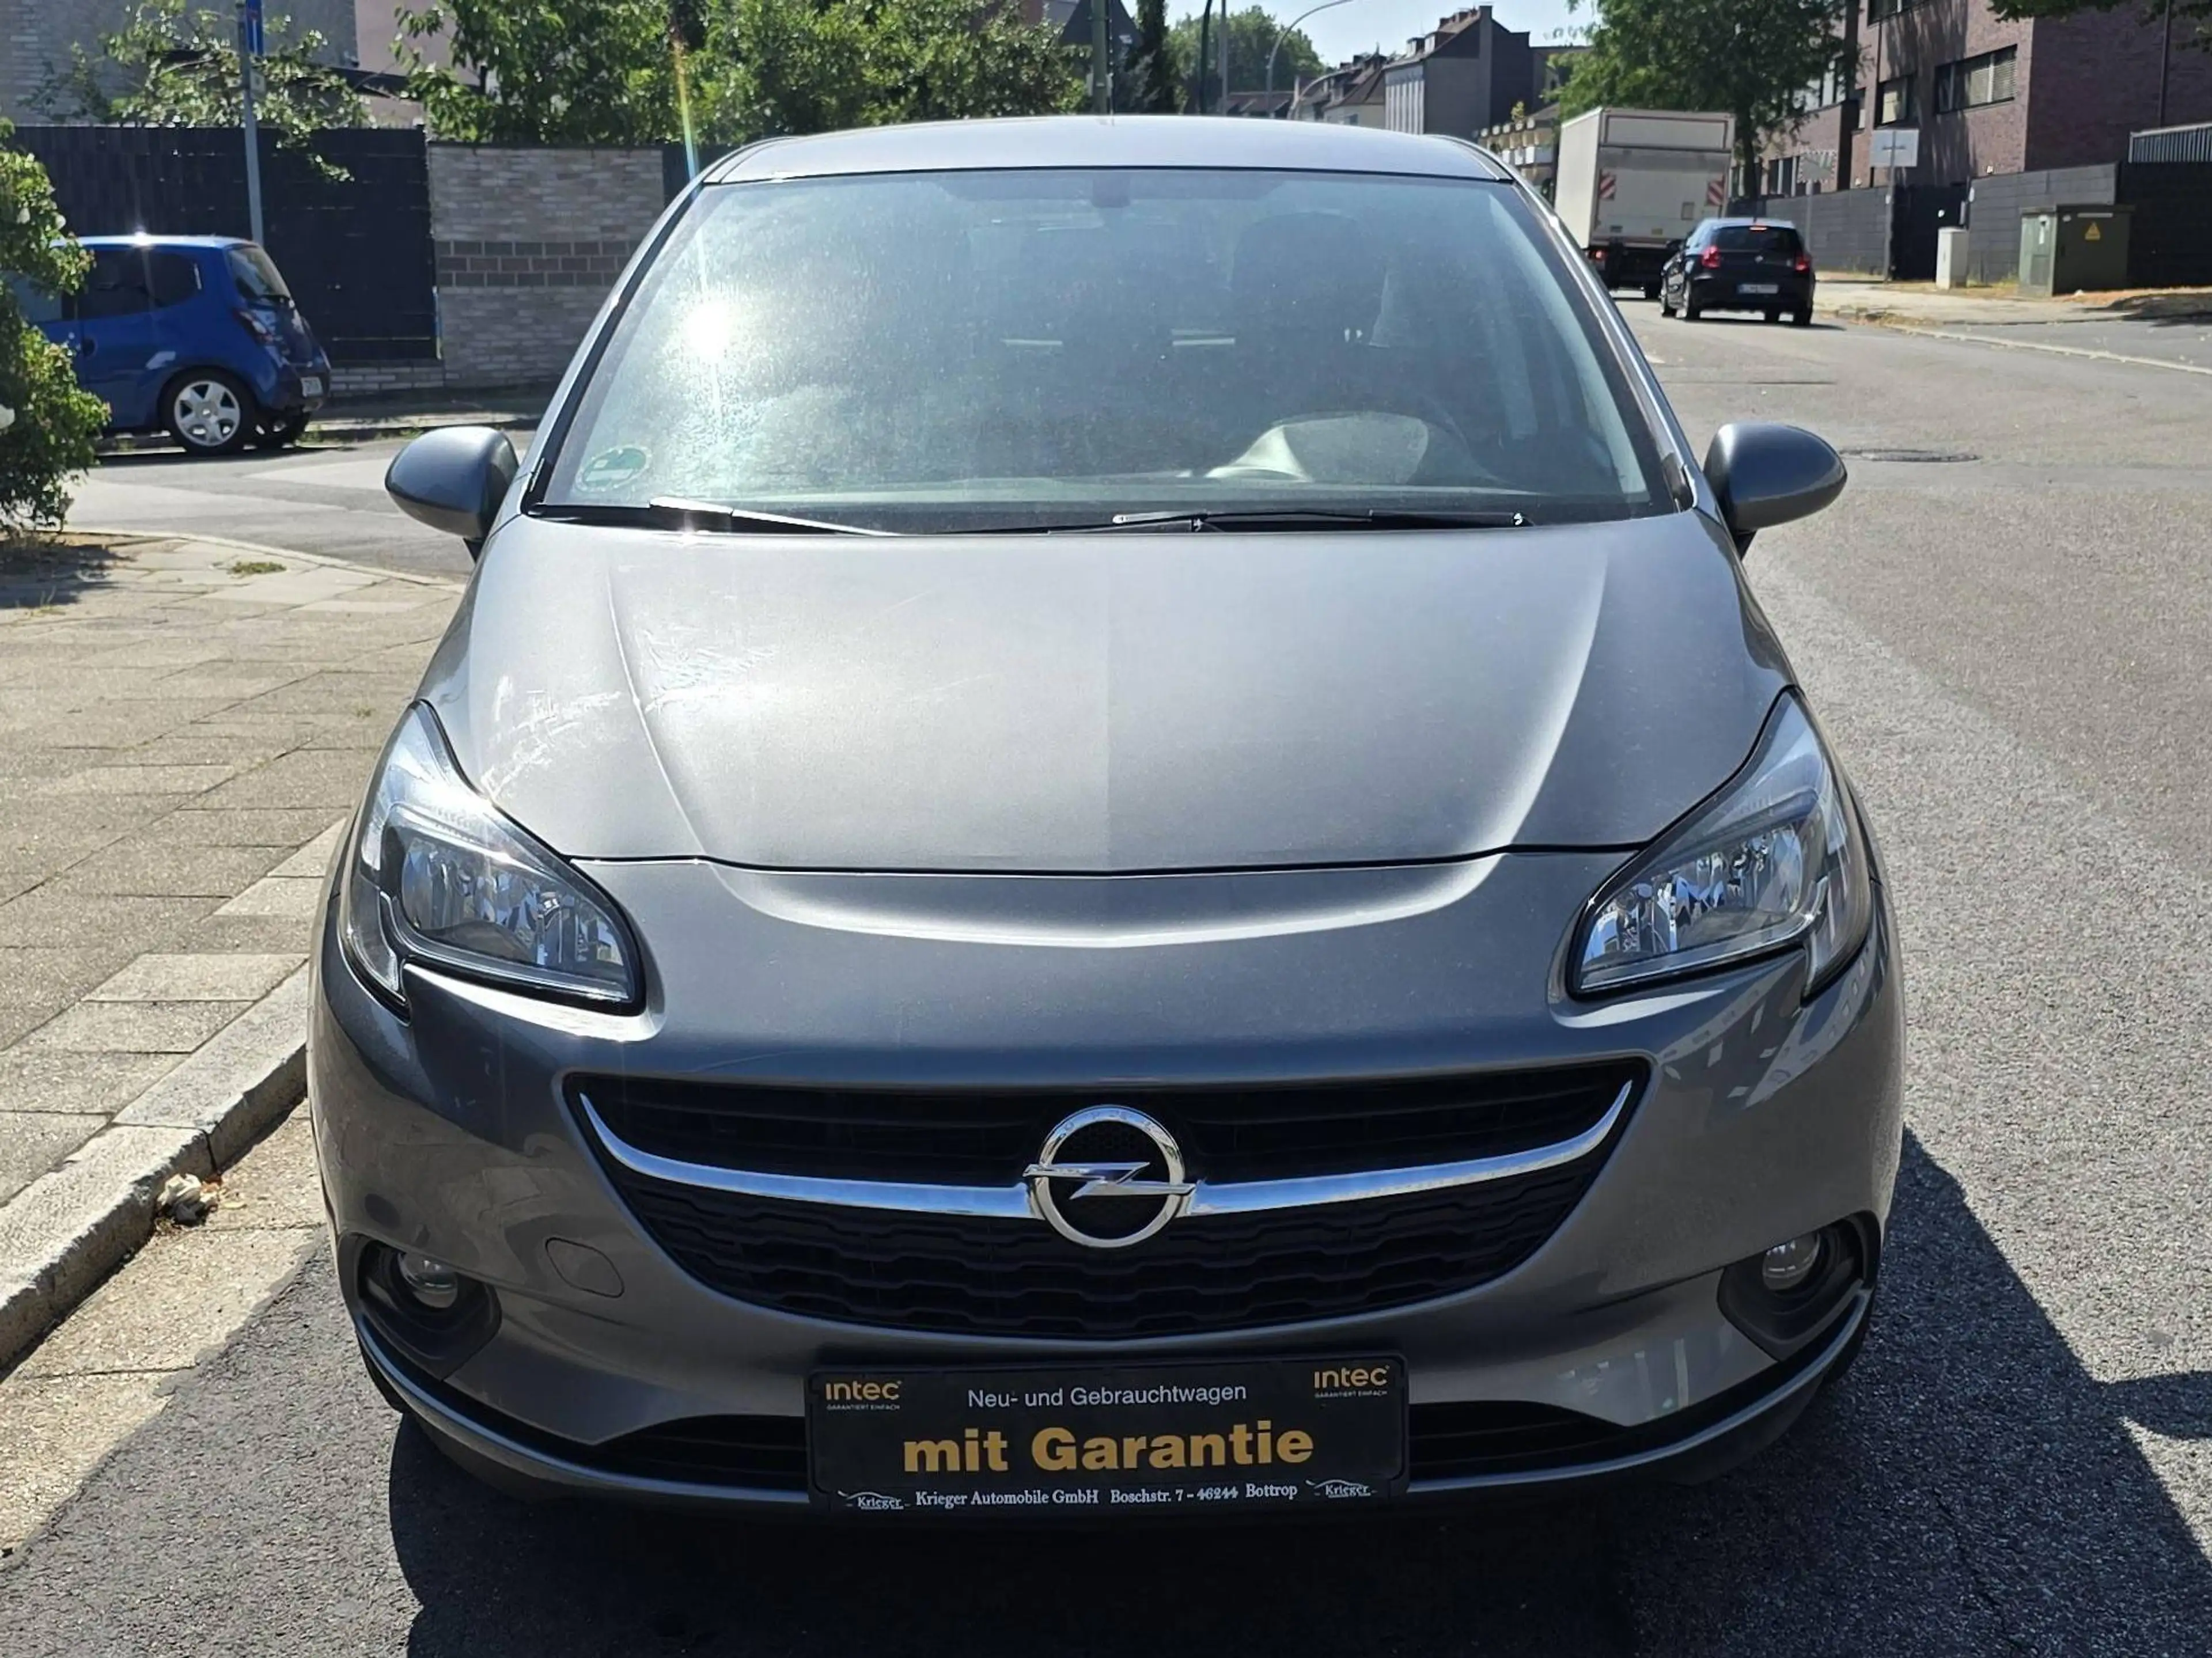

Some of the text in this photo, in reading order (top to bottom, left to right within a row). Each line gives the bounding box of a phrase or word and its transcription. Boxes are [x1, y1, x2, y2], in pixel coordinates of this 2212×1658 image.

[968, 1385, 1247, 1407] Neu- und Gebrauchtwagen
[903, 1420, 1314, 1473] mit Garantie
[915, 1491, 968, 1509] Krieger
[971, 1490, 1049, 1505] Automobile
[1052, 1489, 1099, 1504] GmbH
[1110, 1489, 1172, 1504] Boschstr.
[1176, 1488, 1183, 1501] 7
[1196, 1487, 1238, 1501] 46244
[1245, 1483, 1298, 1500] Bottrop
